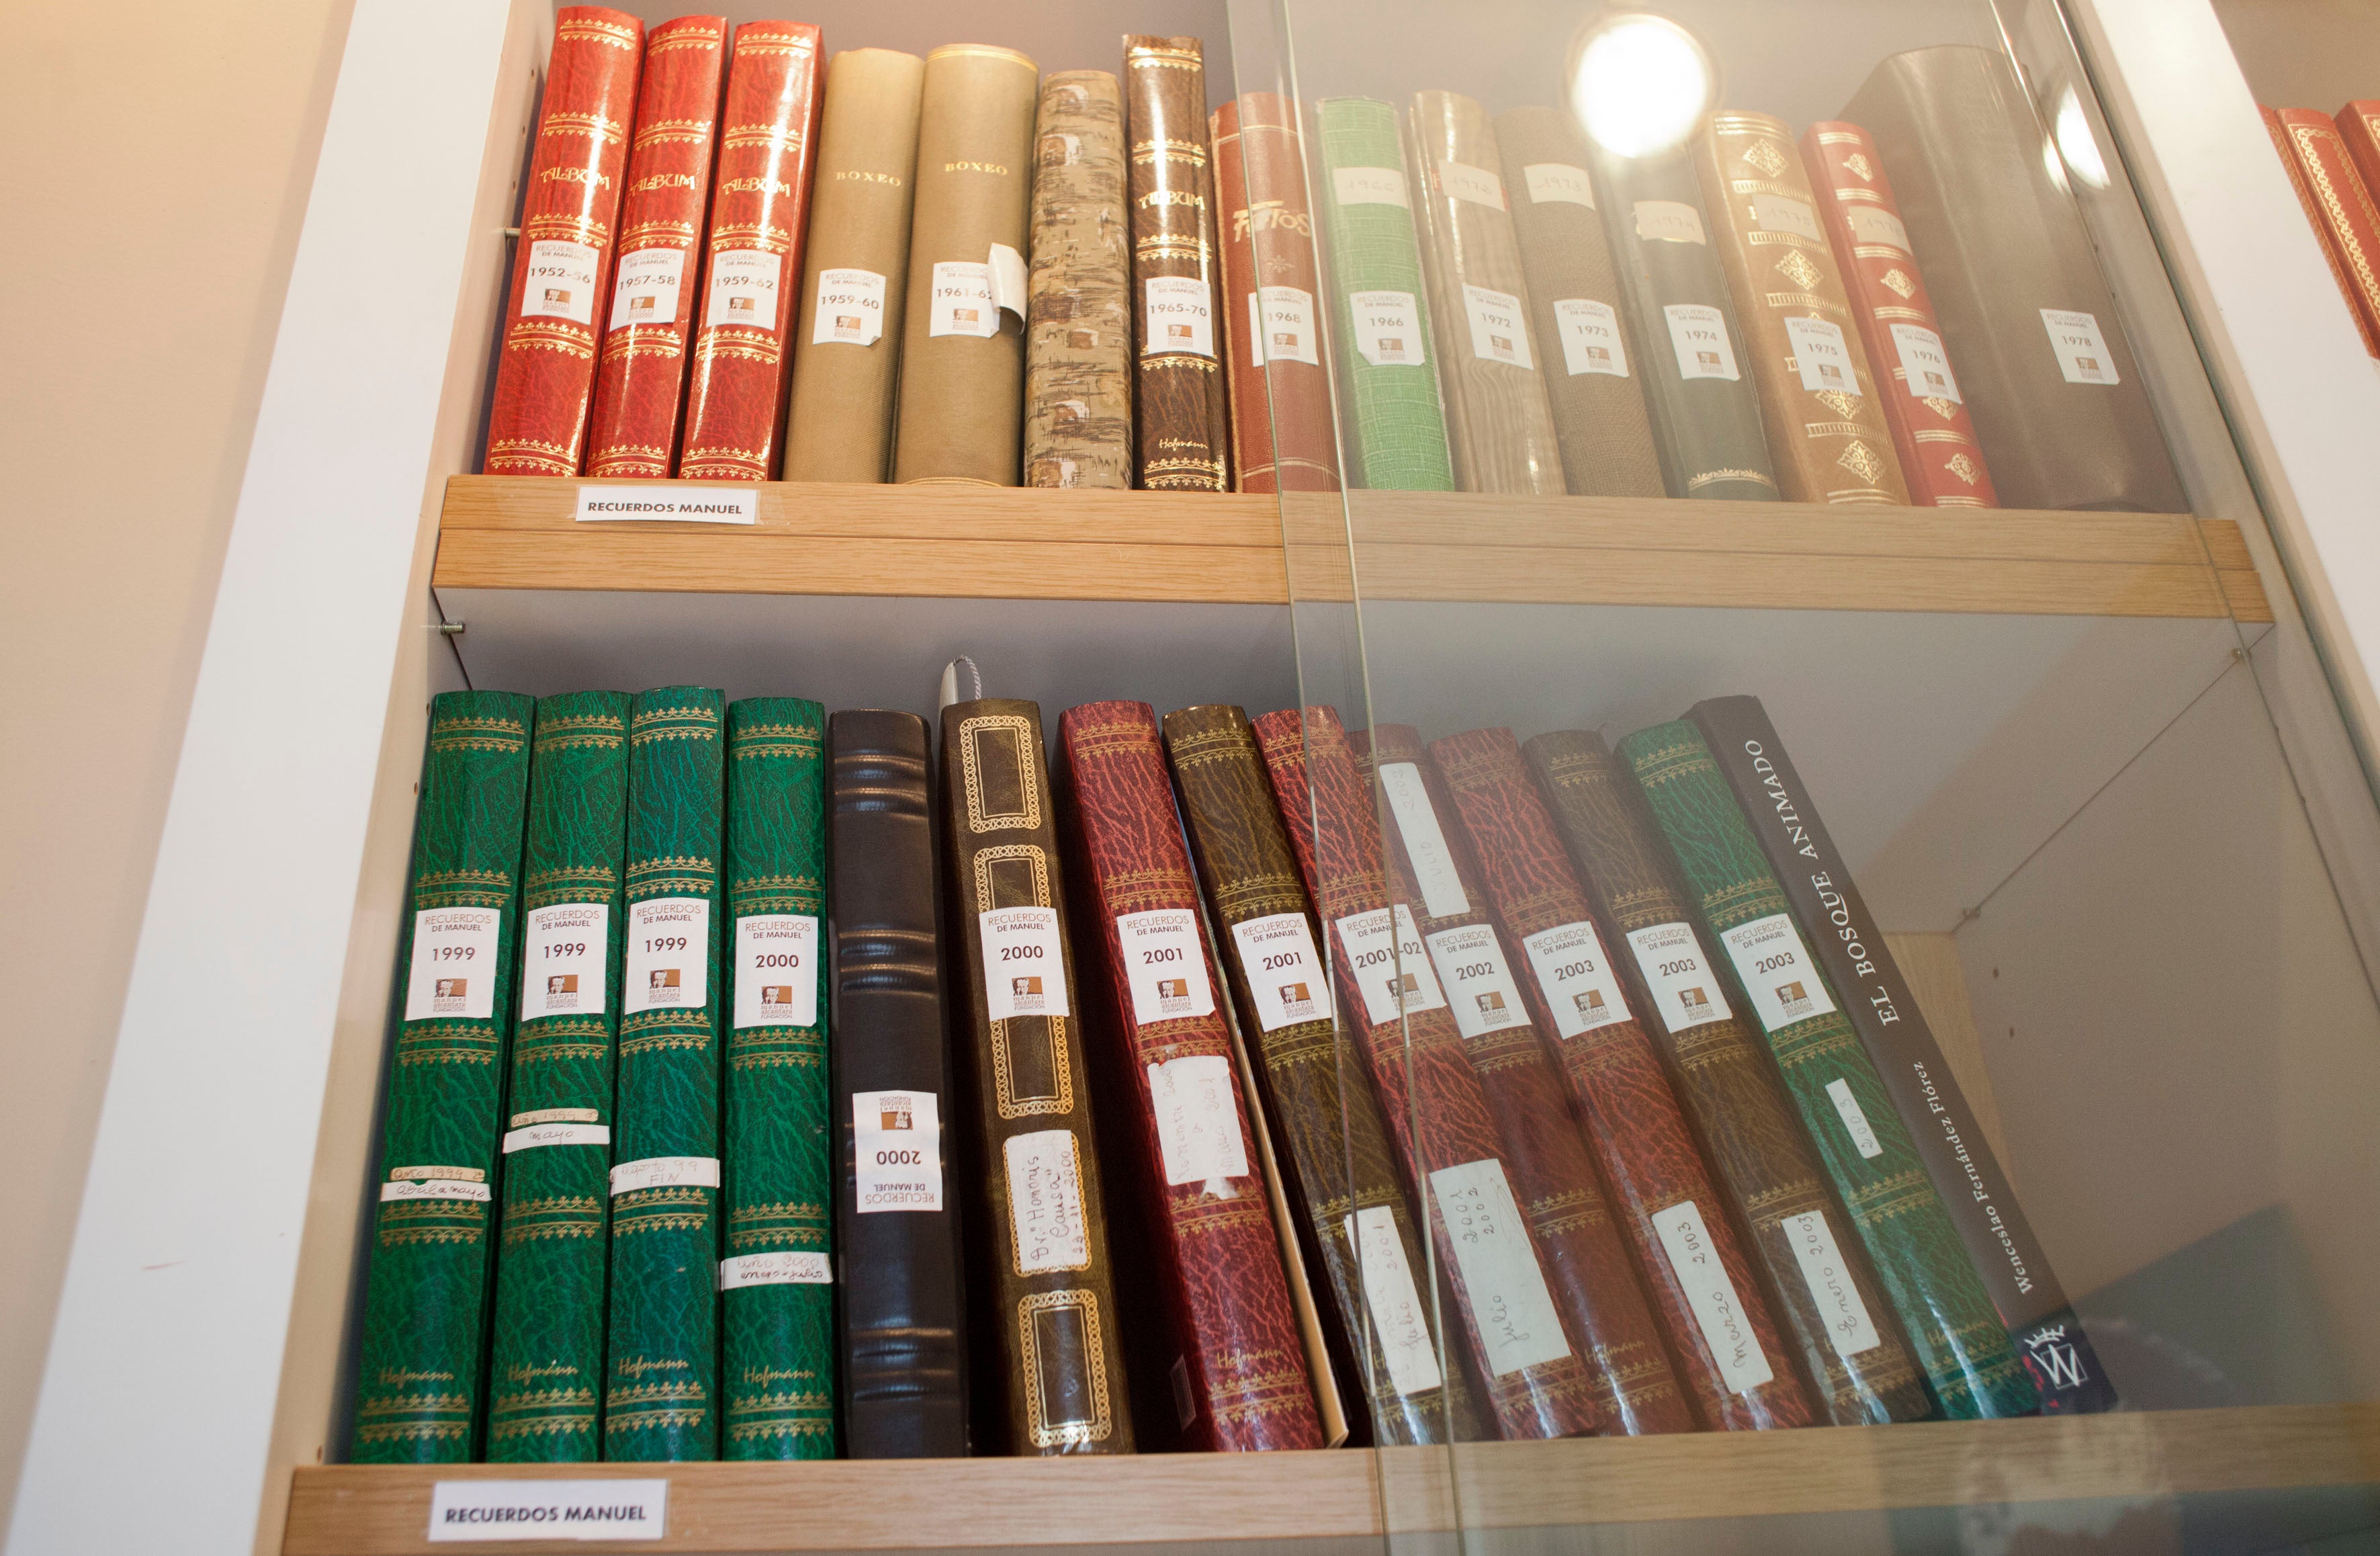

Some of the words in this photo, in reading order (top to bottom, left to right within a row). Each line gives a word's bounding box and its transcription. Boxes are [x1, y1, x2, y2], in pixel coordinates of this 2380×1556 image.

[945, 161, 1008, 175] BOXEO
[630, 174, 695, 196] ALBUM
[836, 171, 901, 187] BOXEO
[530, 267, 590, 284] 1952-56
[619, 275, 676, 290] 1957-58
[716, 276, 774, 290] 1959-62
[821, 295, 879, 310] 1959-60
[1150, 303, 1207, 317] 1965-70
[1268, 312, 1301, 323] 1968
[1370, 317, 1404, 327] 1966
[1481, 312, 1511, 328] 1972
[1577, 325, 1609, 337] 1973
[1685, 330, 1717, 341] 1974
[2062, 335, 2092, 347] 1978
[1808, 343, 1838, 356] 1975
[1912, 349, 1940, 364] 1976
[1159, 437, 1208, 451] Hofmann
[588, 502, 674, 512] RECUERDOS
[679, 504, 742, 514] MANUEL
[1745, 740, 1818, 859] ANIMADO
[535, 910, 599, 924] RECUERDOS
[636, 904, 701, 918] RECUERDOS
[425, 913, 492, 925] RECUERDOS
[542, 922, 554, 931] DE
[554, 920, 591, 928] MANUEL
[644, 916, 654, 924] DE
[746, 921, 811, 932] RECUERDOS
[988, 913, 1051, 926] RECUERDOS
[1127, 915, 1189, 930] RECUERDOS
[1811, 871, 1876, 978] BOSQUE
[997, 924, 1008, 933] DE
[1010, 922, 1045, 931] MANUEL
[1137, 928, 1148, 936] DE
[1149, 925, 1184, 934] MANUEL
[1243, 919, 1303, 938] RECUERDOS
[1731, 920, 1788, 945] RECUERDOS
[1253, 935, 1264, 943] DE
[1266, 930, 1299, 940] MANUEL
[1436, 930, 1491, 948] RECUERDOS
[1532, 927, 1590, 951] RECUERDOS
[1637, 928, 1689, 945] RECUERDOS
[1743, 939, 1755, 949] DE
[1756, 931, 1786, 944] MANUEL
[543, 943, 586, 959] 1999
[645, 937, 687, 953] 1999
[1447, 945, 1457, 953] DE
[1458, 940, 1489, 950] MANUEL
[1544, 946, 1554, 955] DE
[1556, 938, 1587, 951] MANUEL
[1648, 942, 1659, 951] DE
[1660, 938, 1688, 948] MANUEL
[433, 947, 476, 961] 1999
[1001, 945, 1043, 961] 2000
[1143, 948, 1183, 965] 2001
[1356, 941, 1421, 969] 2001-02
[756, 955, 799, 968] 2000
[1263, 951, 1302, 971] 2001
[1659, 959, 1696, 977] 2003
[1756, 952, 1795, 974] 2003
[1456, 961, 1495, 981] 2002
[1554, 959, 1595, 982] 2003
[1870, 986, 1900, 1026] EL
[1914, 1062, 1945, 1115] Flórez
[529, 1131, 574, 1144] mayo
[876, 1150, 920, 1165] 2000
[1941, 1117, 1990, 1203] Fernández
[874, 1183, 911, 1192] MANUEL
[913, 1183, 926, 1191] DE
[866, 1193, 934, 1204] RECUERDOS
[1677, 1221, 1706, 1264] 2003
[1798, 1215, 1823, 1255] 2003
[1986, 1205, 2033, 1294] Wenceslao
[1217, 1347, 1283, 1371] Hofmann
[619, 1355, 689, 1379] Hofmann
[744, 1365, 815, 1389] Hofmann
[445, 1507, 558, 1522] RECUERDOS
[564, 1506, 647, 1522] MANUEL
